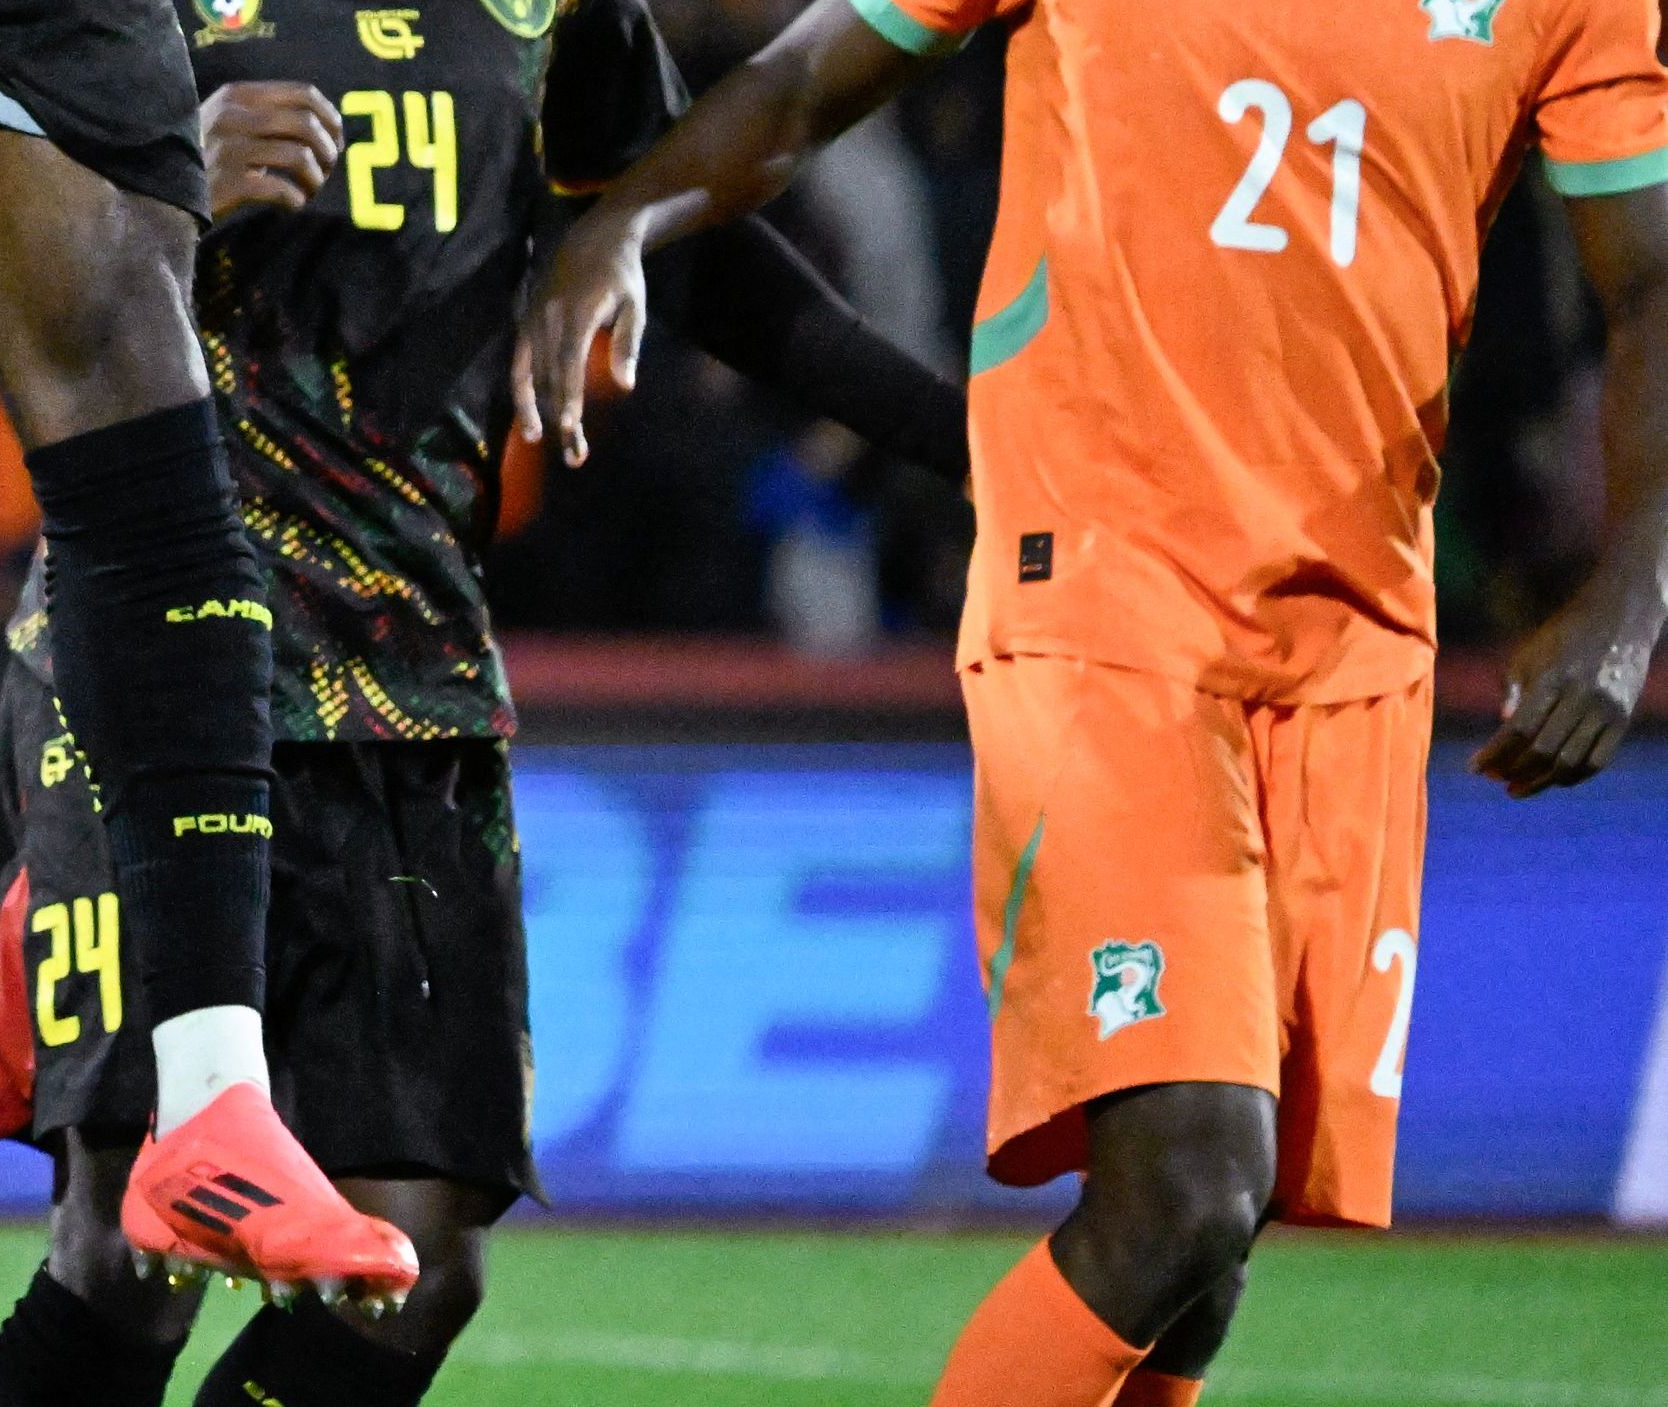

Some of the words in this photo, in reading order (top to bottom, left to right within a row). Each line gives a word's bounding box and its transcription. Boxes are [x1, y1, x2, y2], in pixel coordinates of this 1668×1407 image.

[340, 90, 458, 233] 24
[1209, 77, 1369, 269] 21
[31, 892, 123, 1047] 24
